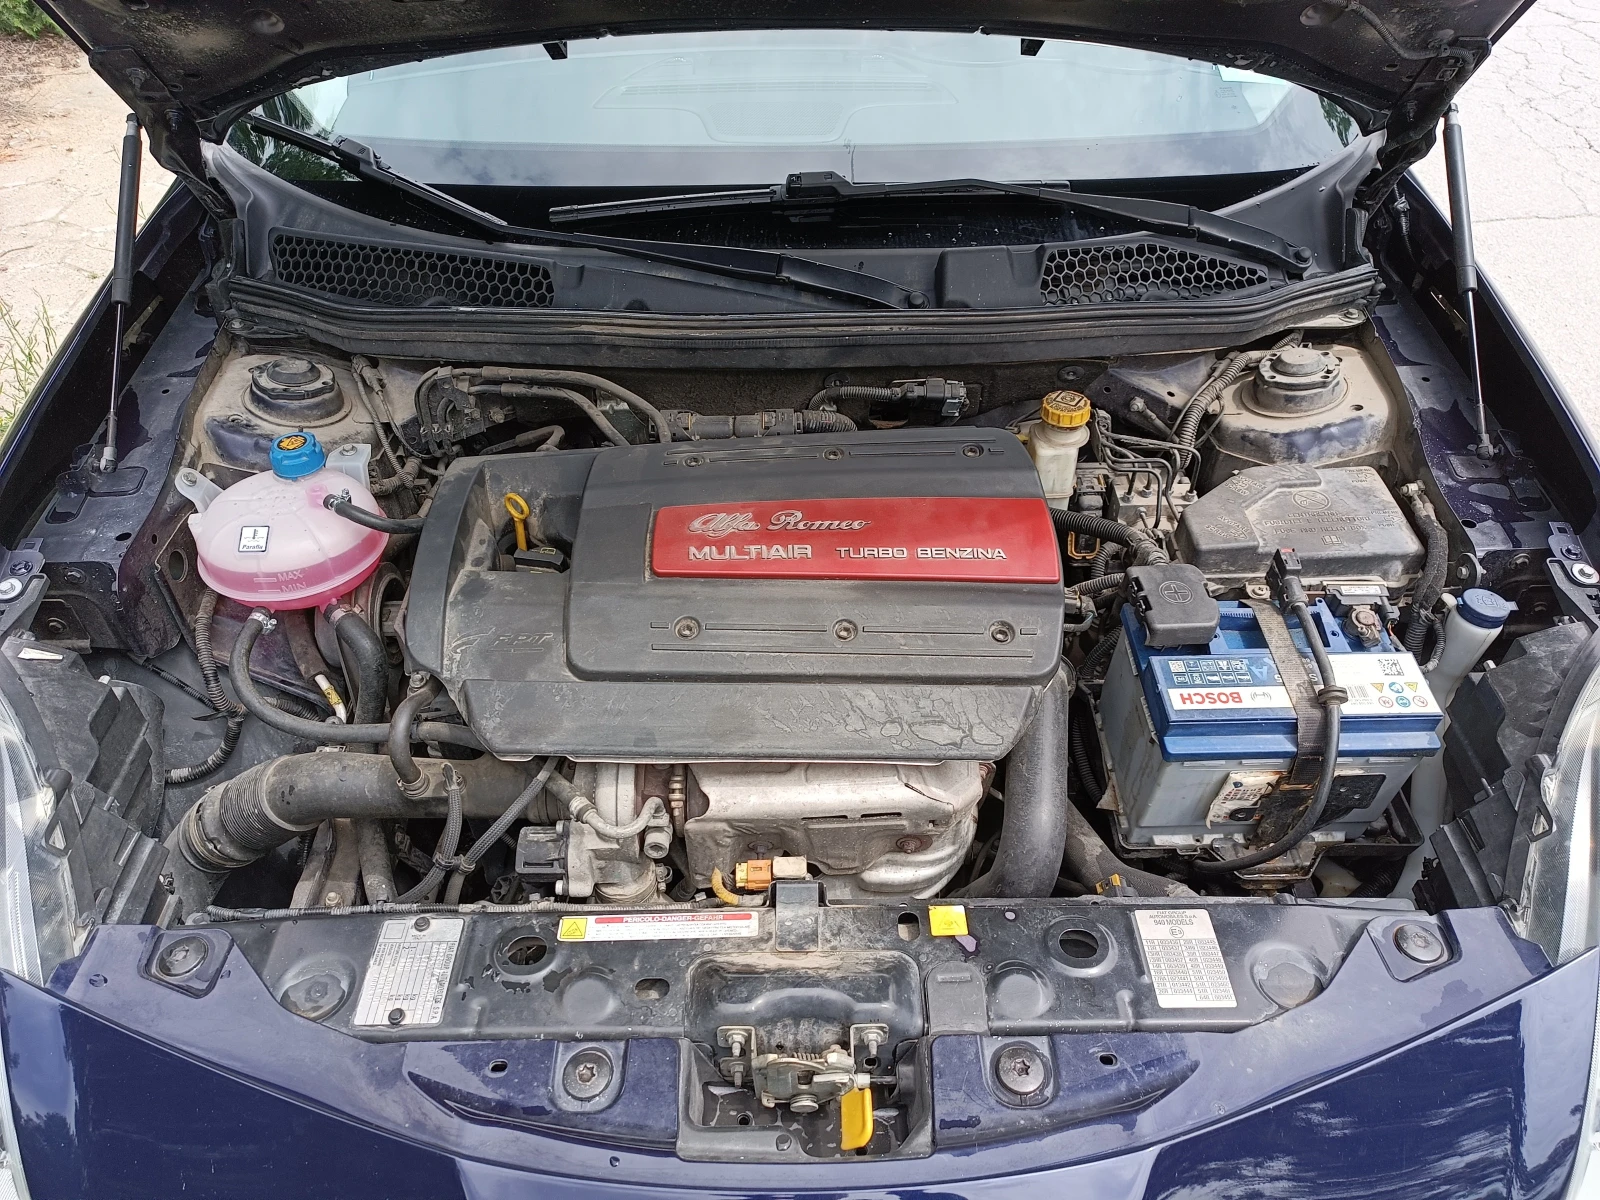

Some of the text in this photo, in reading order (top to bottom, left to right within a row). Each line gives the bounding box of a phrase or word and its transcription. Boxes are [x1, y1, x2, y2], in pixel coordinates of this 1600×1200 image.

[688, 509, 872, 540] Alfa Romeo
[1216, 514, 1250, 533] AVVITARE
[688, 544, 1008, 562] MULTIAIR TURBO BENZINA
[278, 570, 304, 582] MAX
[282, 582, 308, 594] MIN
[1179, 691, 1243, 705] BOSCH
[622, 914, 724, 924] PERICOLO-DANGER-GEFAHR
